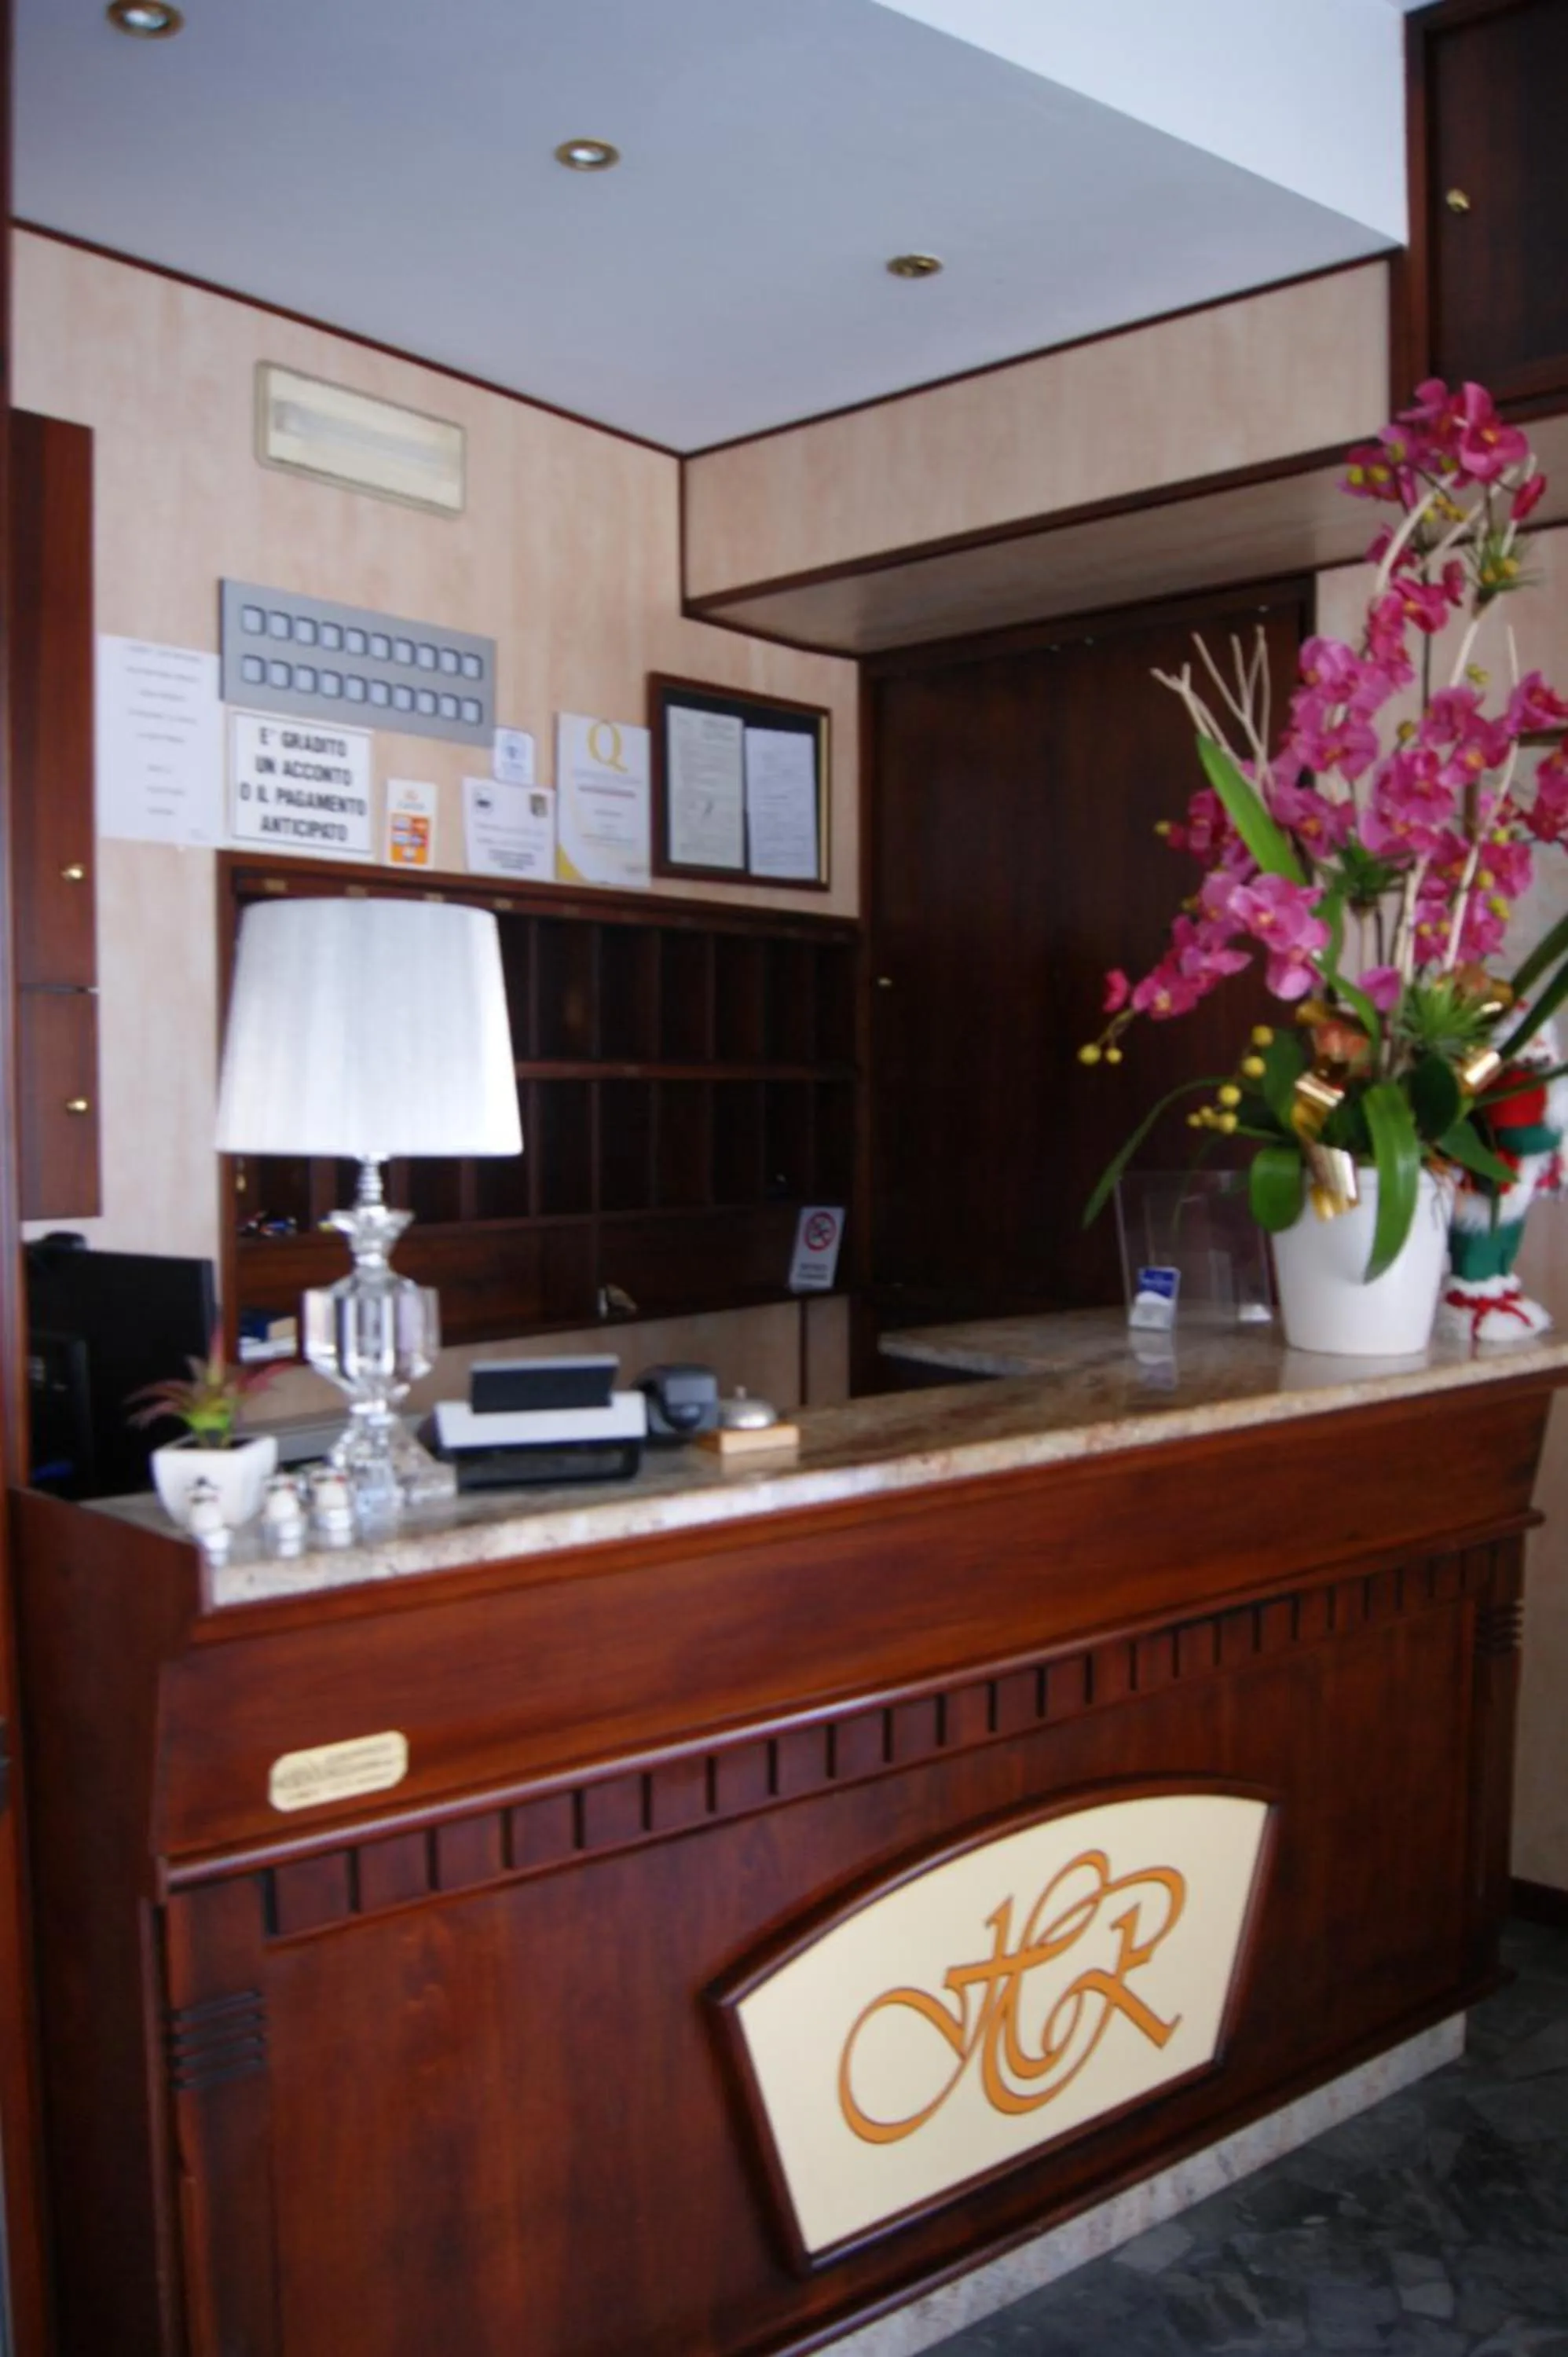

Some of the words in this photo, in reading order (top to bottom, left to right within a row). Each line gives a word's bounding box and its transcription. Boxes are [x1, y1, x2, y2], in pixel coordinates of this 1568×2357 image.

[280, 730, 348, 757] GRADITO
[255, 755, 276, 774] UN
[281, 760, 353, 787] ACCONTO
[239, 782, 251, 801] O
[256, 785, 269, 804] IL
[275, 786, 367, 816] PAGAMENTO
[260, 815, 349, 841] ANTICIPATO
